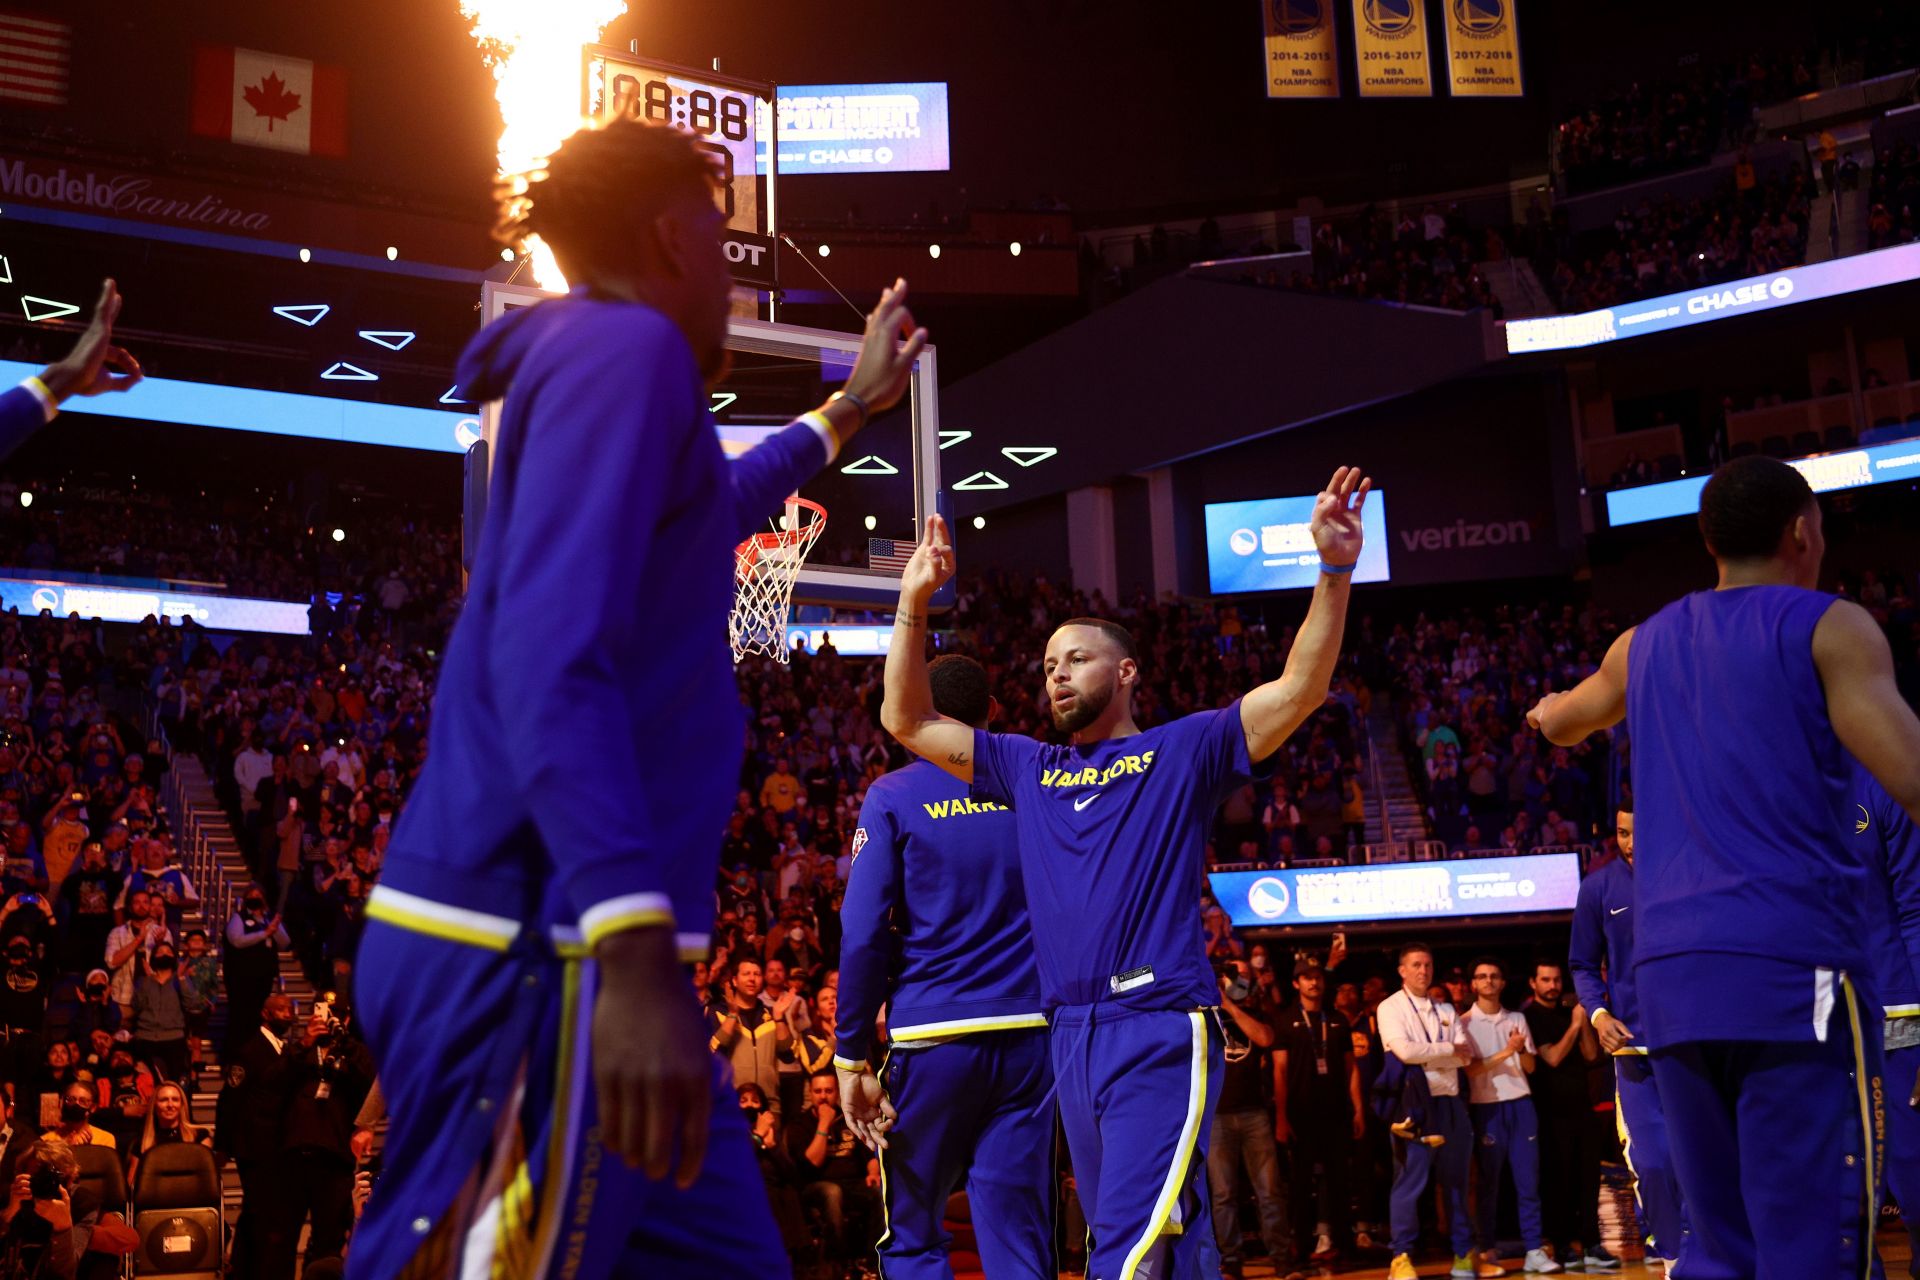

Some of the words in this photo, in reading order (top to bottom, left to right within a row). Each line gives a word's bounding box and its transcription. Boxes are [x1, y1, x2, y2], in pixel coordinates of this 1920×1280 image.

[1365, 24, 1417, 41] WARRIORS
[1456, 24, 1508, 41] WARRIORS
[1272, 52, 1331, 60] 2014-2015
[1363, 51, 1422, 60] 2016-2017
[1455, 51, 1513, 60] 2017-2018
[1291, 68, 1312, 76] NBA
[1474, 67, 1495, 75] NBA
[1273, 78, 1332, 86] CHAMPIONS
[1456, 76, 1515, 85] CHAMPIONS
[846, 126, 920, 140] MONTH
[809, 149, 873, 164] CHASE
[0, 156, 114, 209] Modelo
[109, 174, 272, 231] Cantina
[1687, 282, 1768, 315] CHASE
[1400, 518, 1531, 552] verizon
[923, 797, 1009, 820] WARR
[1458, 881, 1517, 899] CHASE
[1871, 1075, 1885, 1139] GOLDEN
